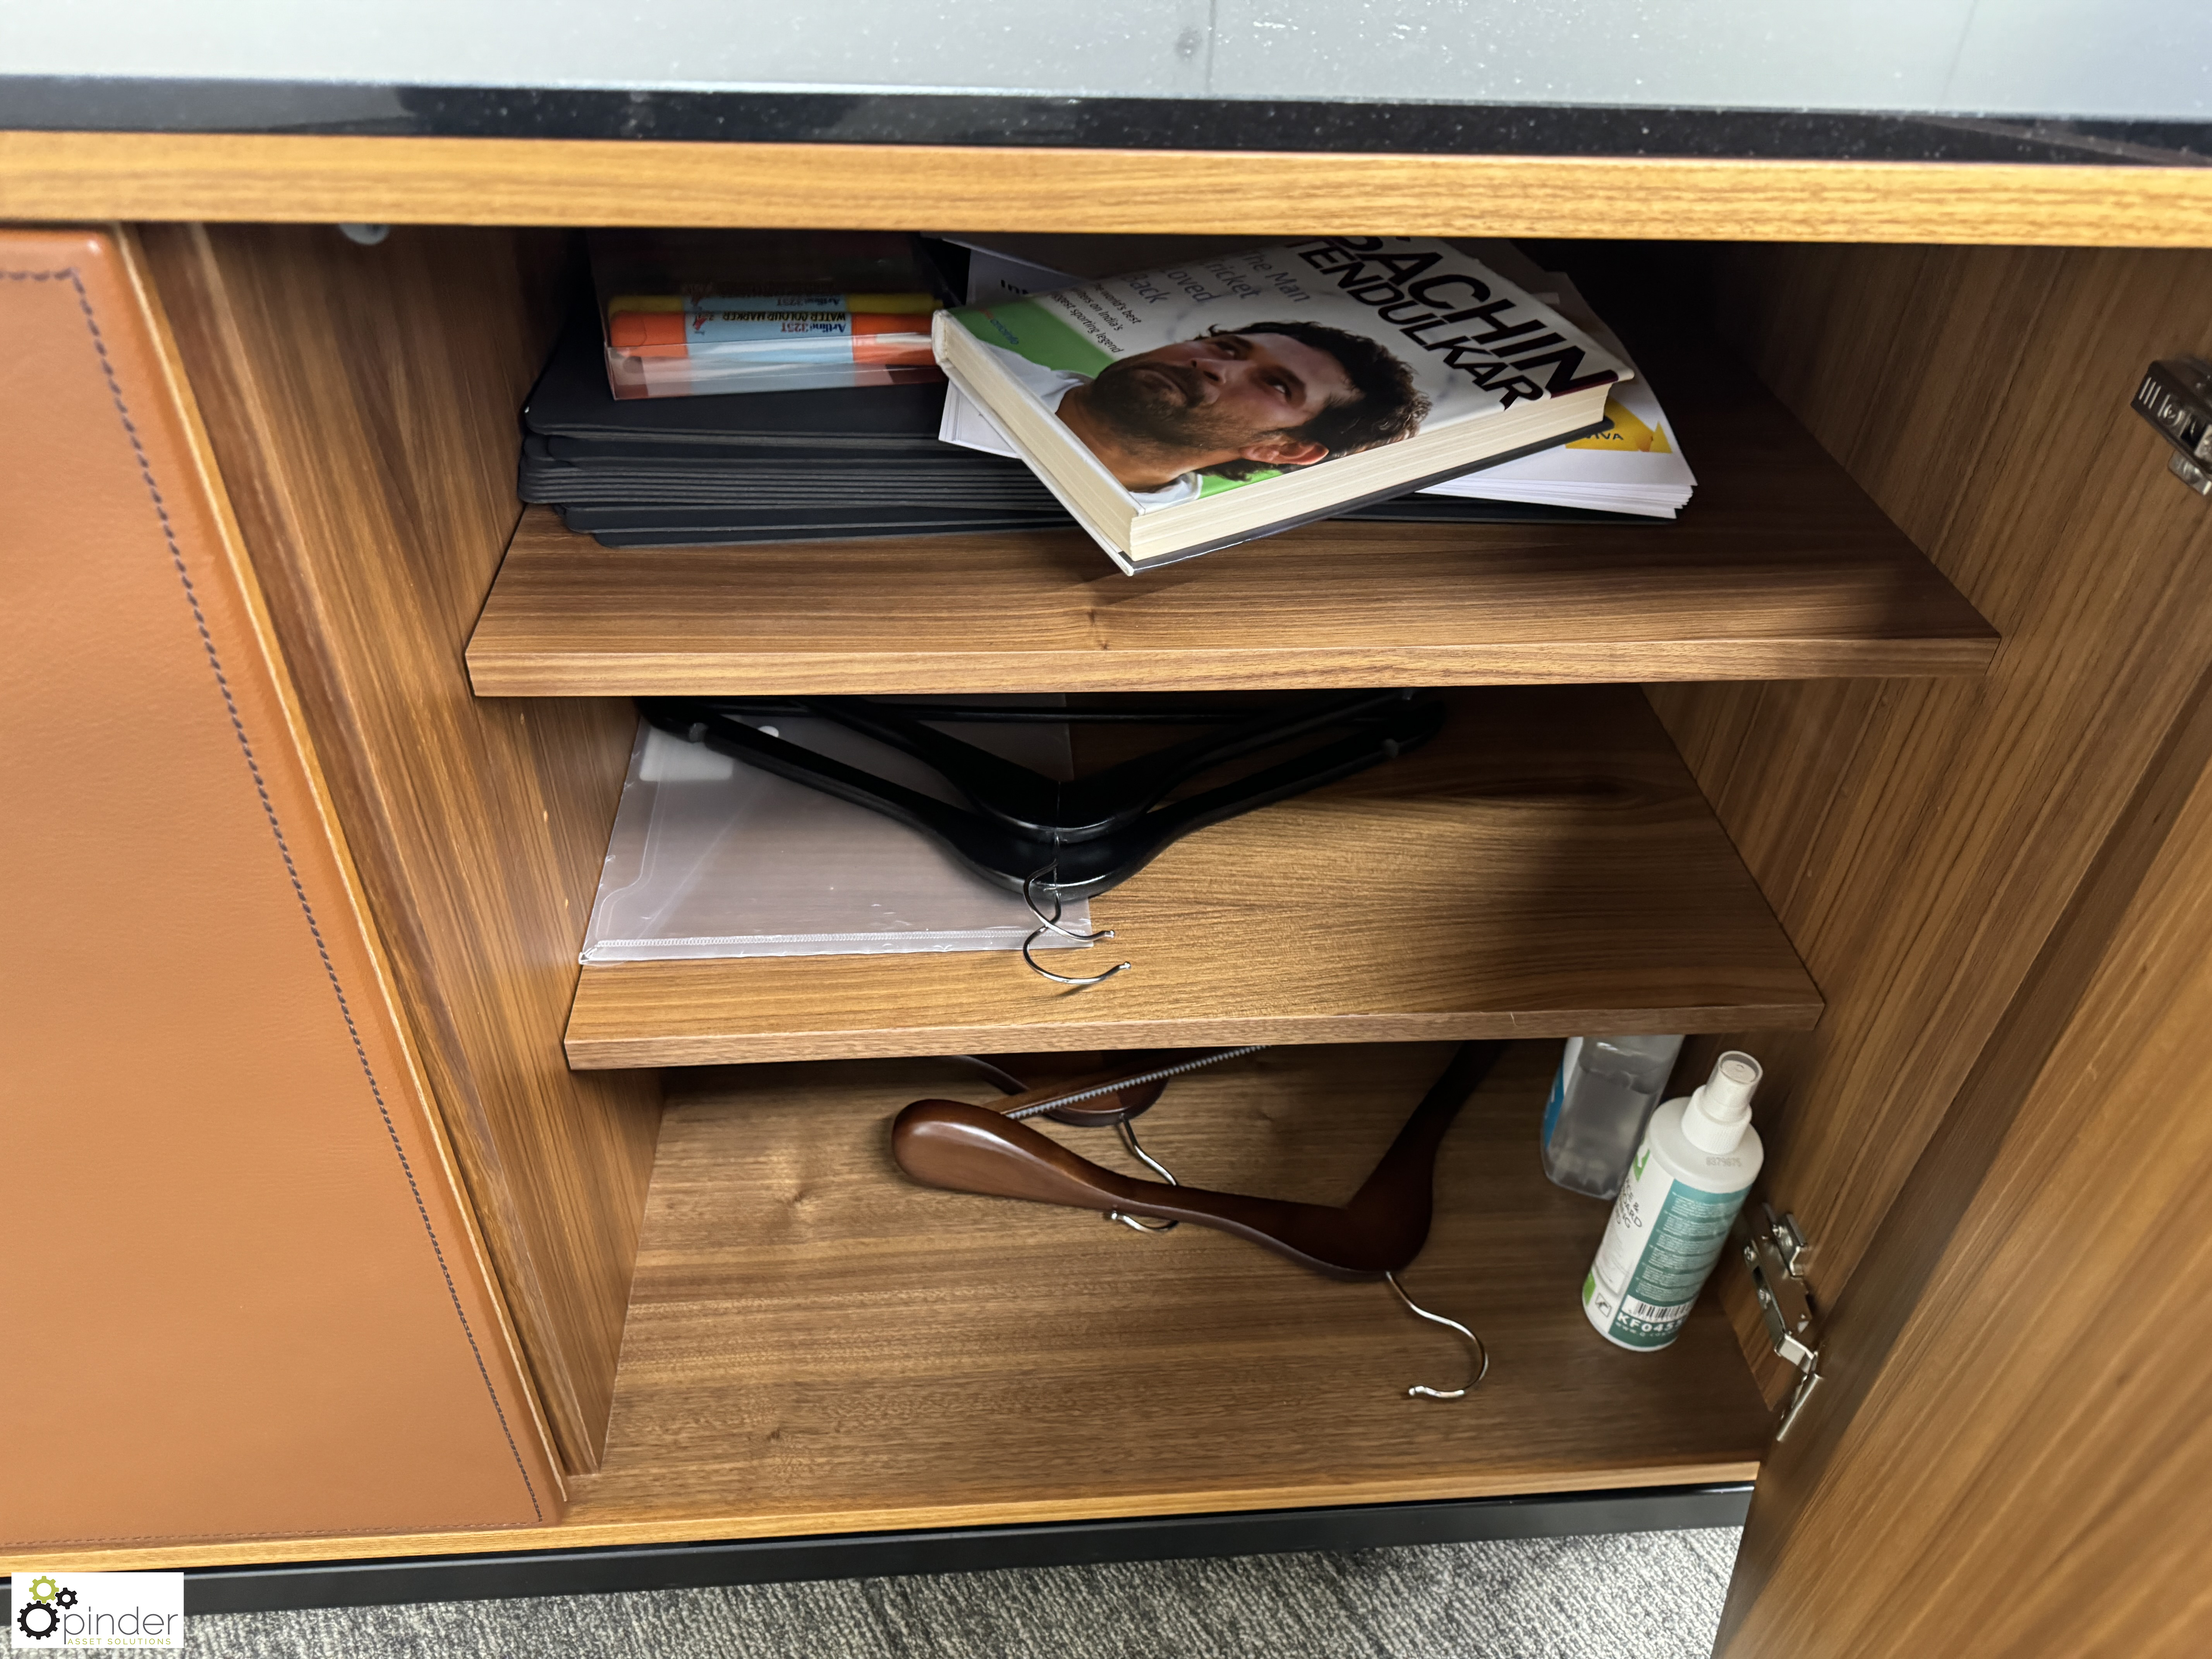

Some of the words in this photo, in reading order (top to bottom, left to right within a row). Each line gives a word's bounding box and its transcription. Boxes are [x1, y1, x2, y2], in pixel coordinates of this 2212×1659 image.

[1265, 272, 1310, 302] Man
[722, 312, 765, 321] MARKER
[767, 312, 808, 321] COLOUR
[811, 312, 845, 321] WATER
[1089, 303, 1103, 311] on
[1098, 311, 1123, 330] India's
[1122, 309, 1141, 324] best
[810, 323, 846, 332] Artline
[1070, 309, 1099, 333] sporting
[1096, 332, 1124, 353] legend
